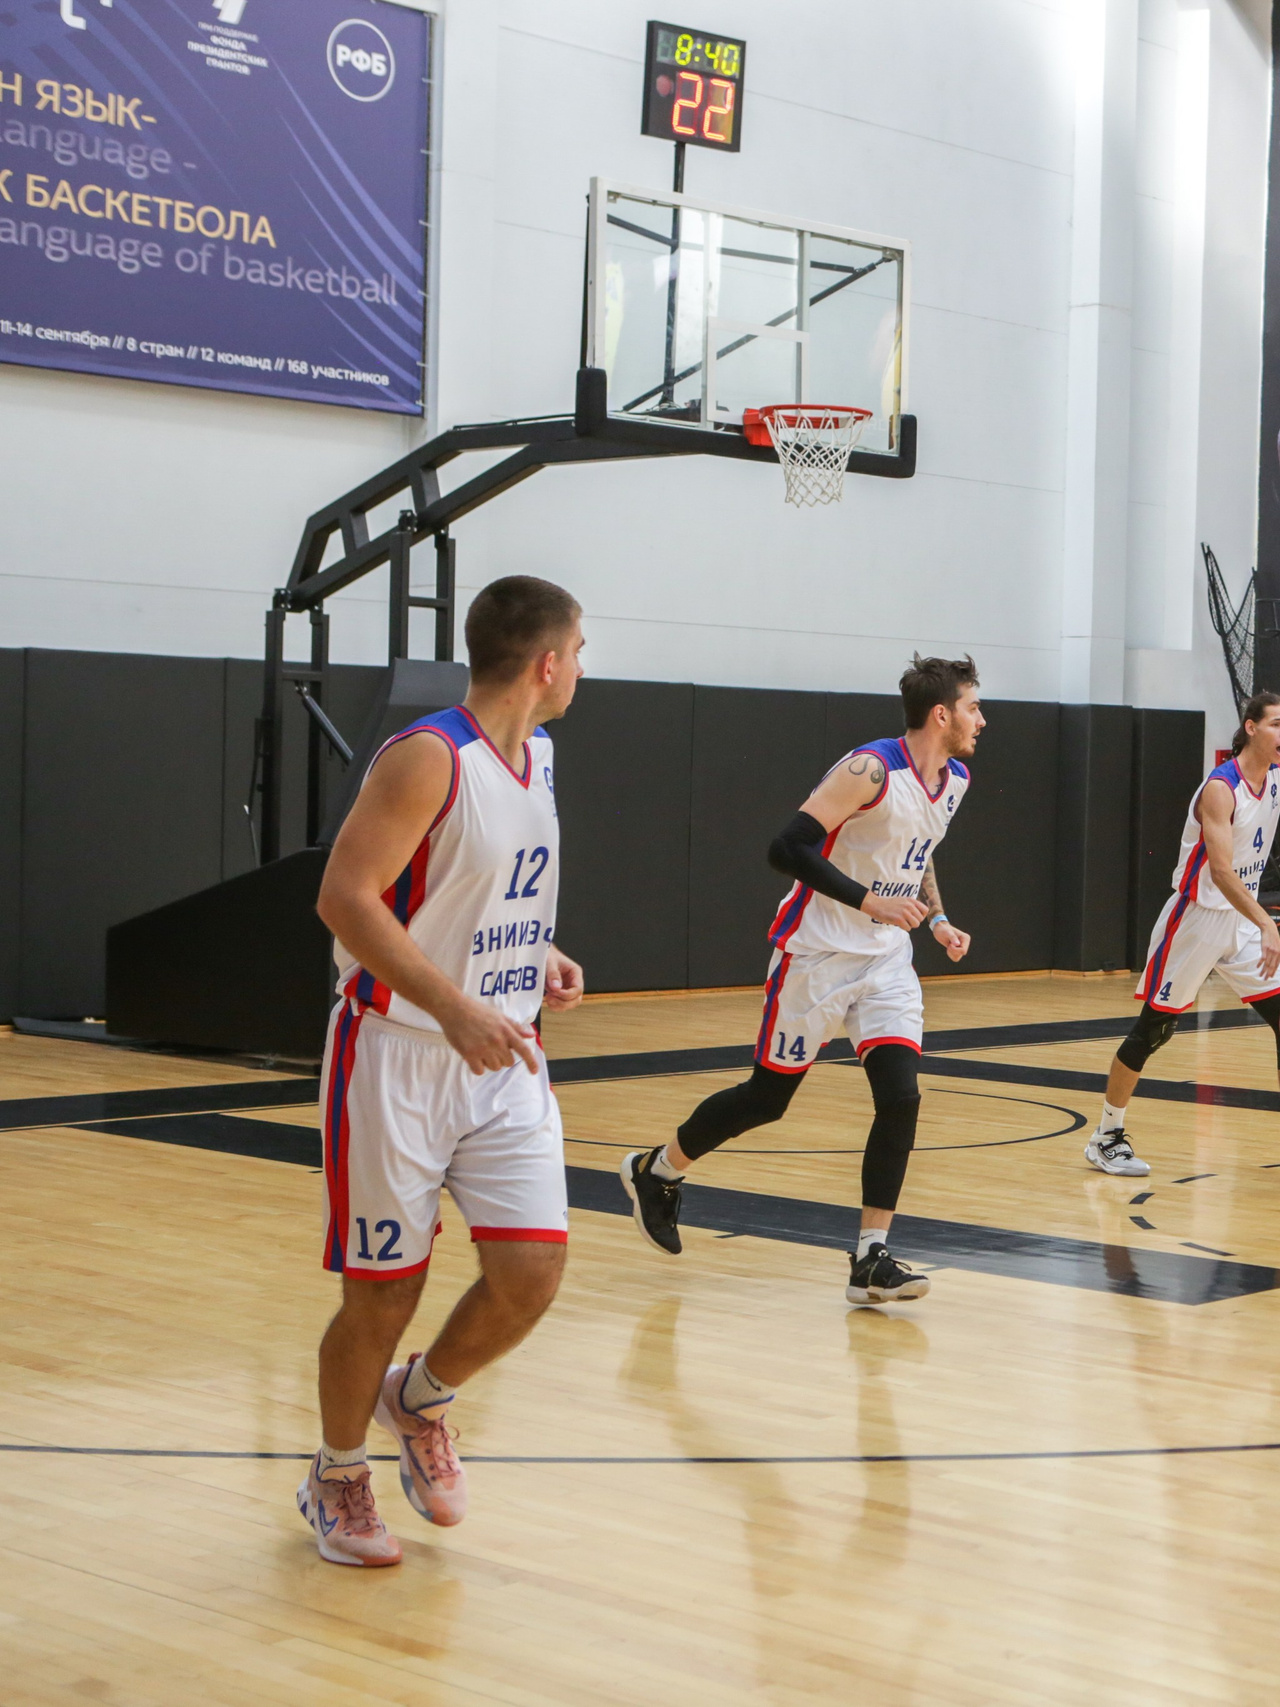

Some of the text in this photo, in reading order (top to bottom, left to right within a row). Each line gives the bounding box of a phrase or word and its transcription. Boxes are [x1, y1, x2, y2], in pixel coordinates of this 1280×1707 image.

[336, 44, 387, 77] РФБ
[674, 33, 740, 76] 8:40
[672, 71, 735, 141] 22
[26, 172, 278, 249] БАСКЕТБОЛА
[175, 242, 216, 275] of
[224, 244, 399, 306] basketball
[35, 326, 110, 350] сентября
[126, 337, 138, 352] 8
[139, 341, 184, 359] стран
[200, 347, 215, 363] 12
[217, 351, 272, 372] команд
[287, 358, 309, 375] 168
[311, 364, 391, 387] участников
[901, 836, 932, 871] 14
[1252, 826, 1264, 853] 4
[504, 846, 550, 901] 12
[1159, 981, 1173, 1001] 4
[775, 1031, 806, 1062] 14
[356, 1217, 403, 1262] 12
